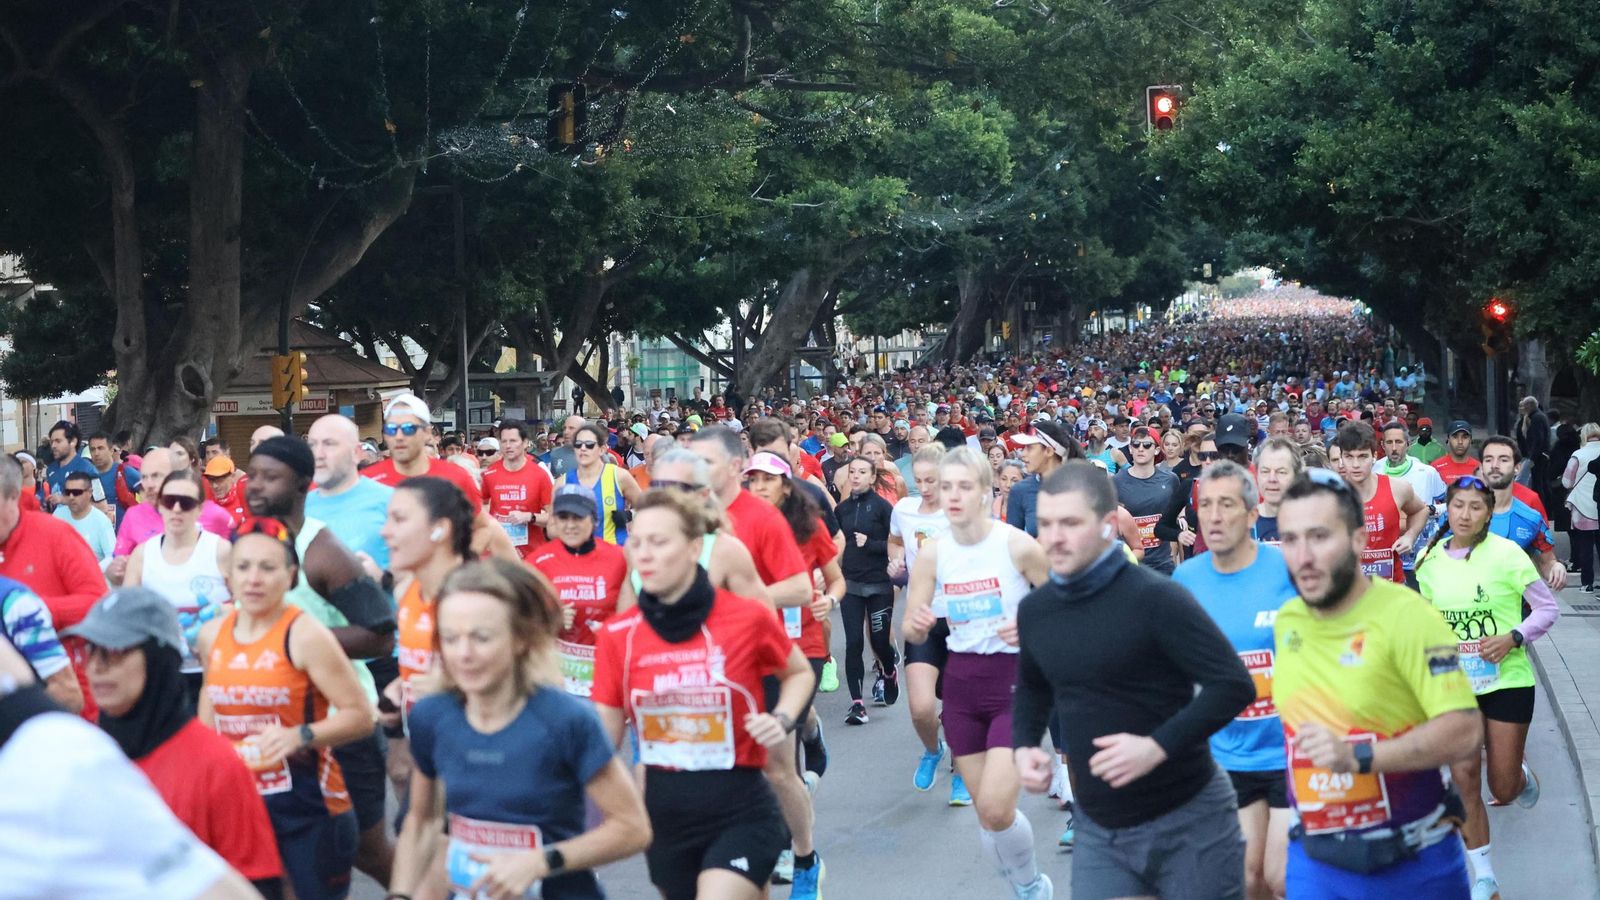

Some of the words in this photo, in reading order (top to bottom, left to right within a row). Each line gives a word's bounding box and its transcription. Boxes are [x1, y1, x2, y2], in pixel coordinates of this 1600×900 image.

[300, 400, 325, 410] ¡HOLA!
[1363, 552, 1391, 560] GENERALI
[957, 578, 996, 593] GENERALI
[560, 587, 596, 600] MÁLAGA
[1308, 772, 1354, 791] 4249
